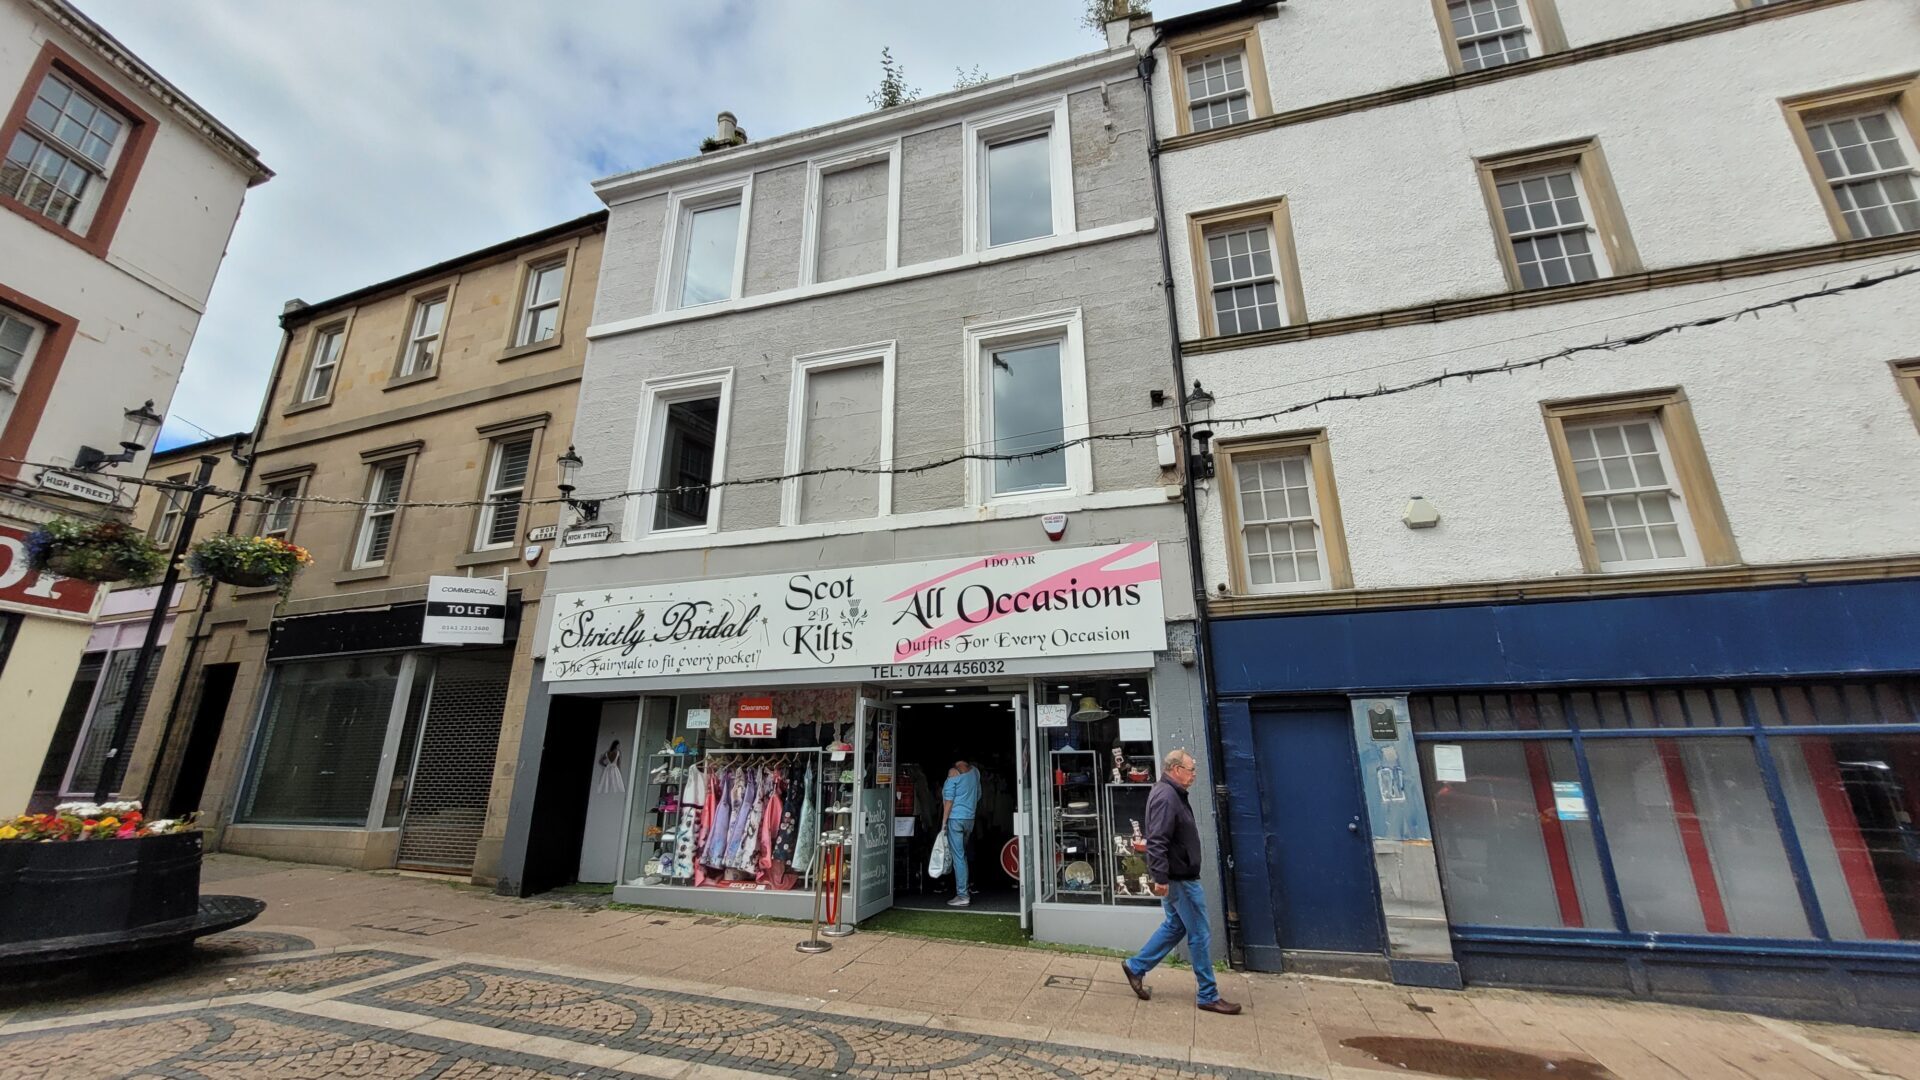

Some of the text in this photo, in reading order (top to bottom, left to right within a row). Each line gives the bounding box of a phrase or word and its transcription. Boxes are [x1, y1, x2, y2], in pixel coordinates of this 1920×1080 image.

[46, 476, 71, 488] HIGH
[992, 557, 1009, 568] DO
[1012, 555, 1036, 567] AYR
[785, 574, 855, 611] Scot
[447, 604, 490, 616] TO LET
[892, 578, 1141, 629] All Occasions
[807, 606, 829, 622] 2B
[561, 600, 761, 656] Strictly Bridal
[783, 623, 854, 664] Kilts
[896, 626, 1130, 657] Outfits For Every Occasion
[586, 656, 644, 676] Fairytale
[647, 659, 659, 669] to
[659, 654, 674, 674] fit
[678, 653, 714, 672] every
[871, 660, 1005, 679] TEL: 07444 456032
[740, 703, 770, 711] Clearance
[733, 722, 773, 736] SALE
